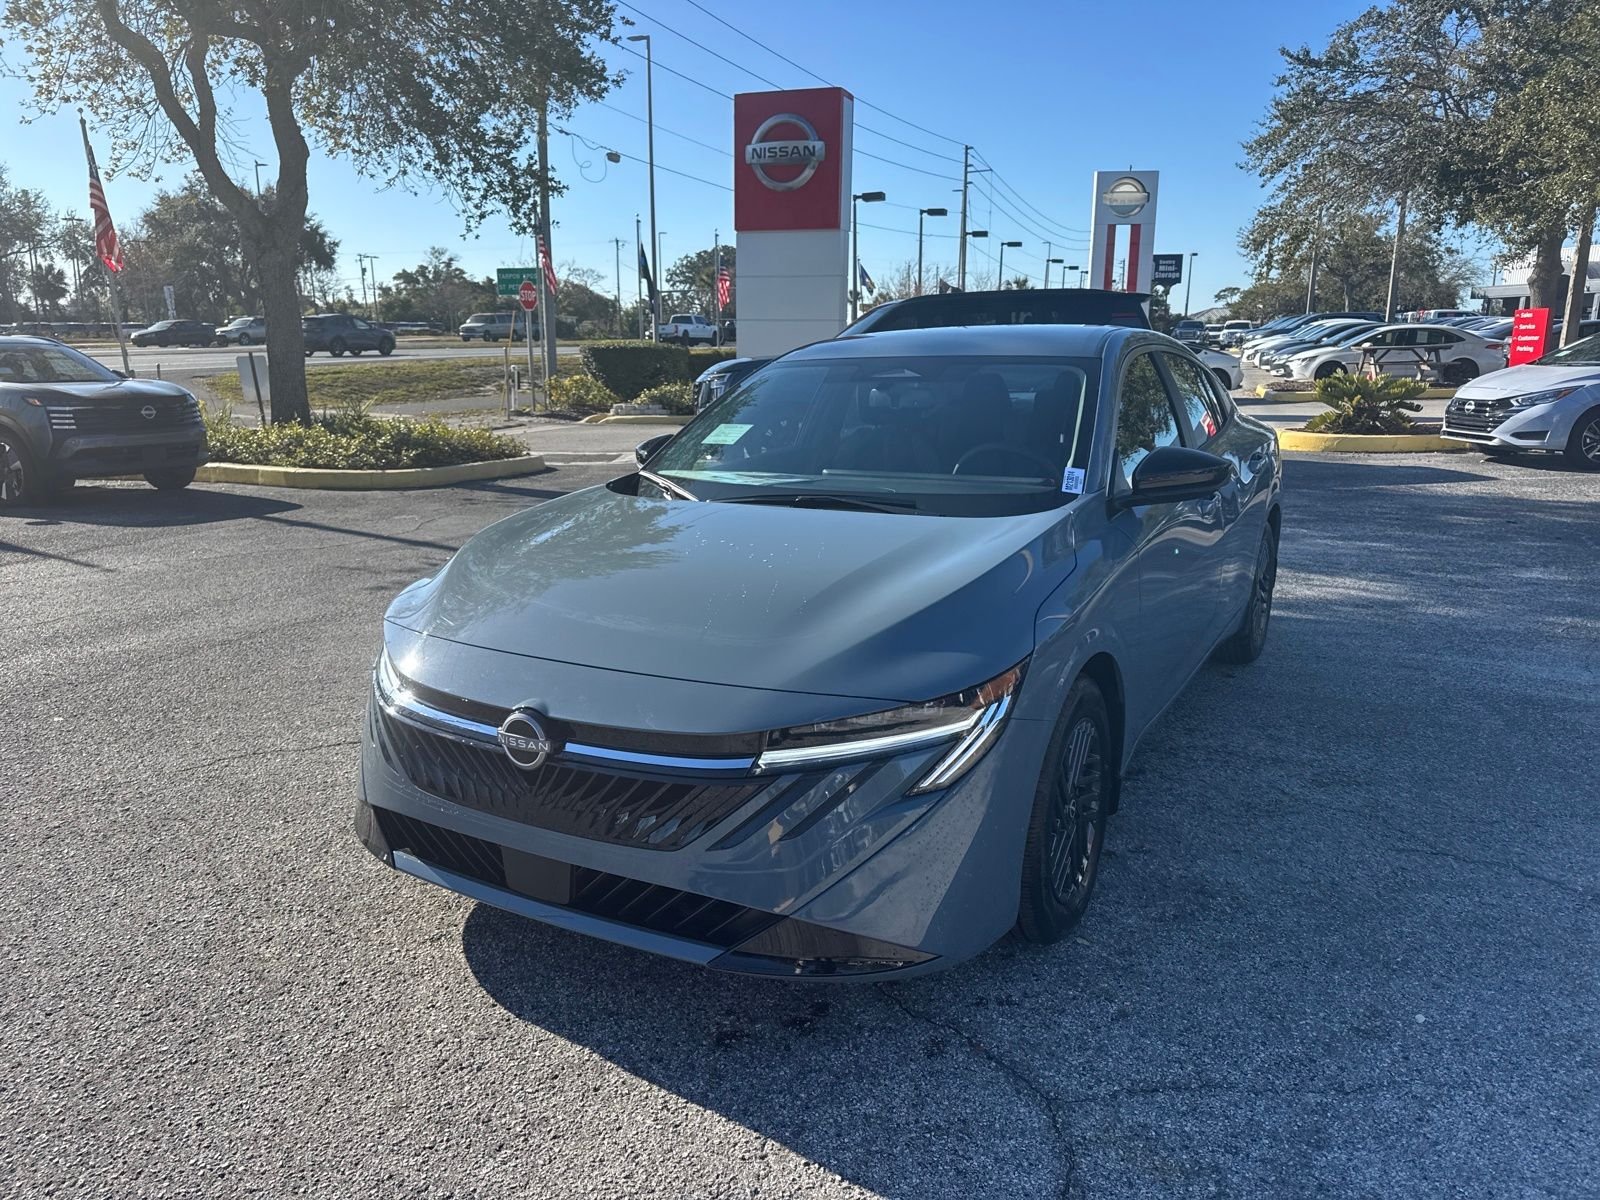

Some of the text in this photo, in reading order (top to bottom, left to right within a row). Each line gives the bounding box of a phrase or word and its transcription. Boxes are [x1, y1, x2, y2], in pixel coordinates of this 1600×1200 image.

[752, 145, 816, 159] NISSAN
[1155, 271, 1180, 279] Storage
[520, 290, 536, 301] STOP
[1516, 345, 1534, 353] Parking
[498, 734, 548, 751] NISSAN
